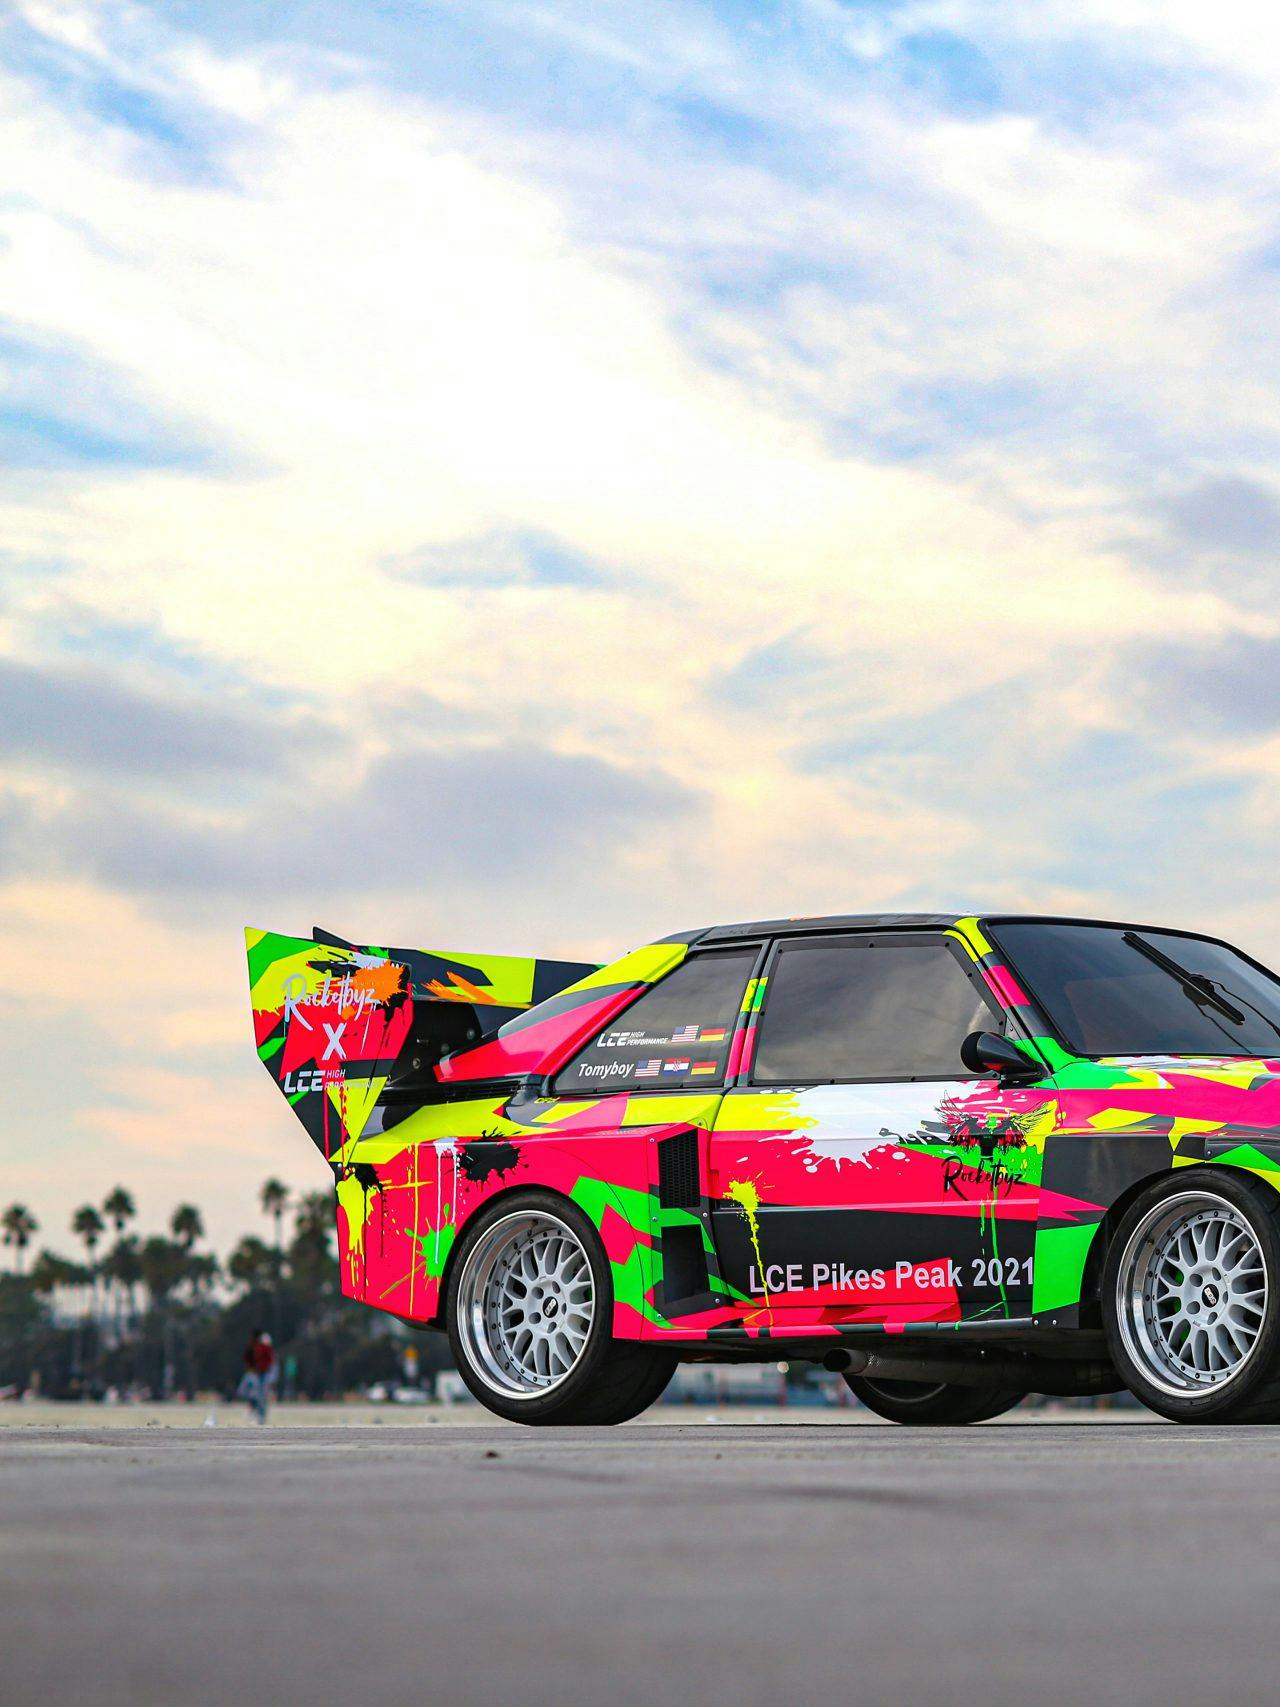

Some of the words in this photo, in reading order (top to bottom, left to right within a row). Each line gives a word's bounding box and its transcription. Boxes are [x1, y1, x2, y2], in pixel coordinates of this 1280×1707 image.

[281, 971, 381, 1031] Rocketbyz
[322, 1022, 347, 1061] X
[596, 1031, 631, 1048] LCE
[626, 1037, 669, 1046] PERFORMANCE
[326, 1069, 346, 1079] HIGH
[578, 1061, 634, 1080] Tomyboy
[283, 1070, 326, 1093] LCE
[749, 1264, 804, 1293] LCE
[812, 1262, 886, 1291] Pikes
[895, 1259, 963, 1289] Peak
[971, 1256, 1034, 1287] 2021
